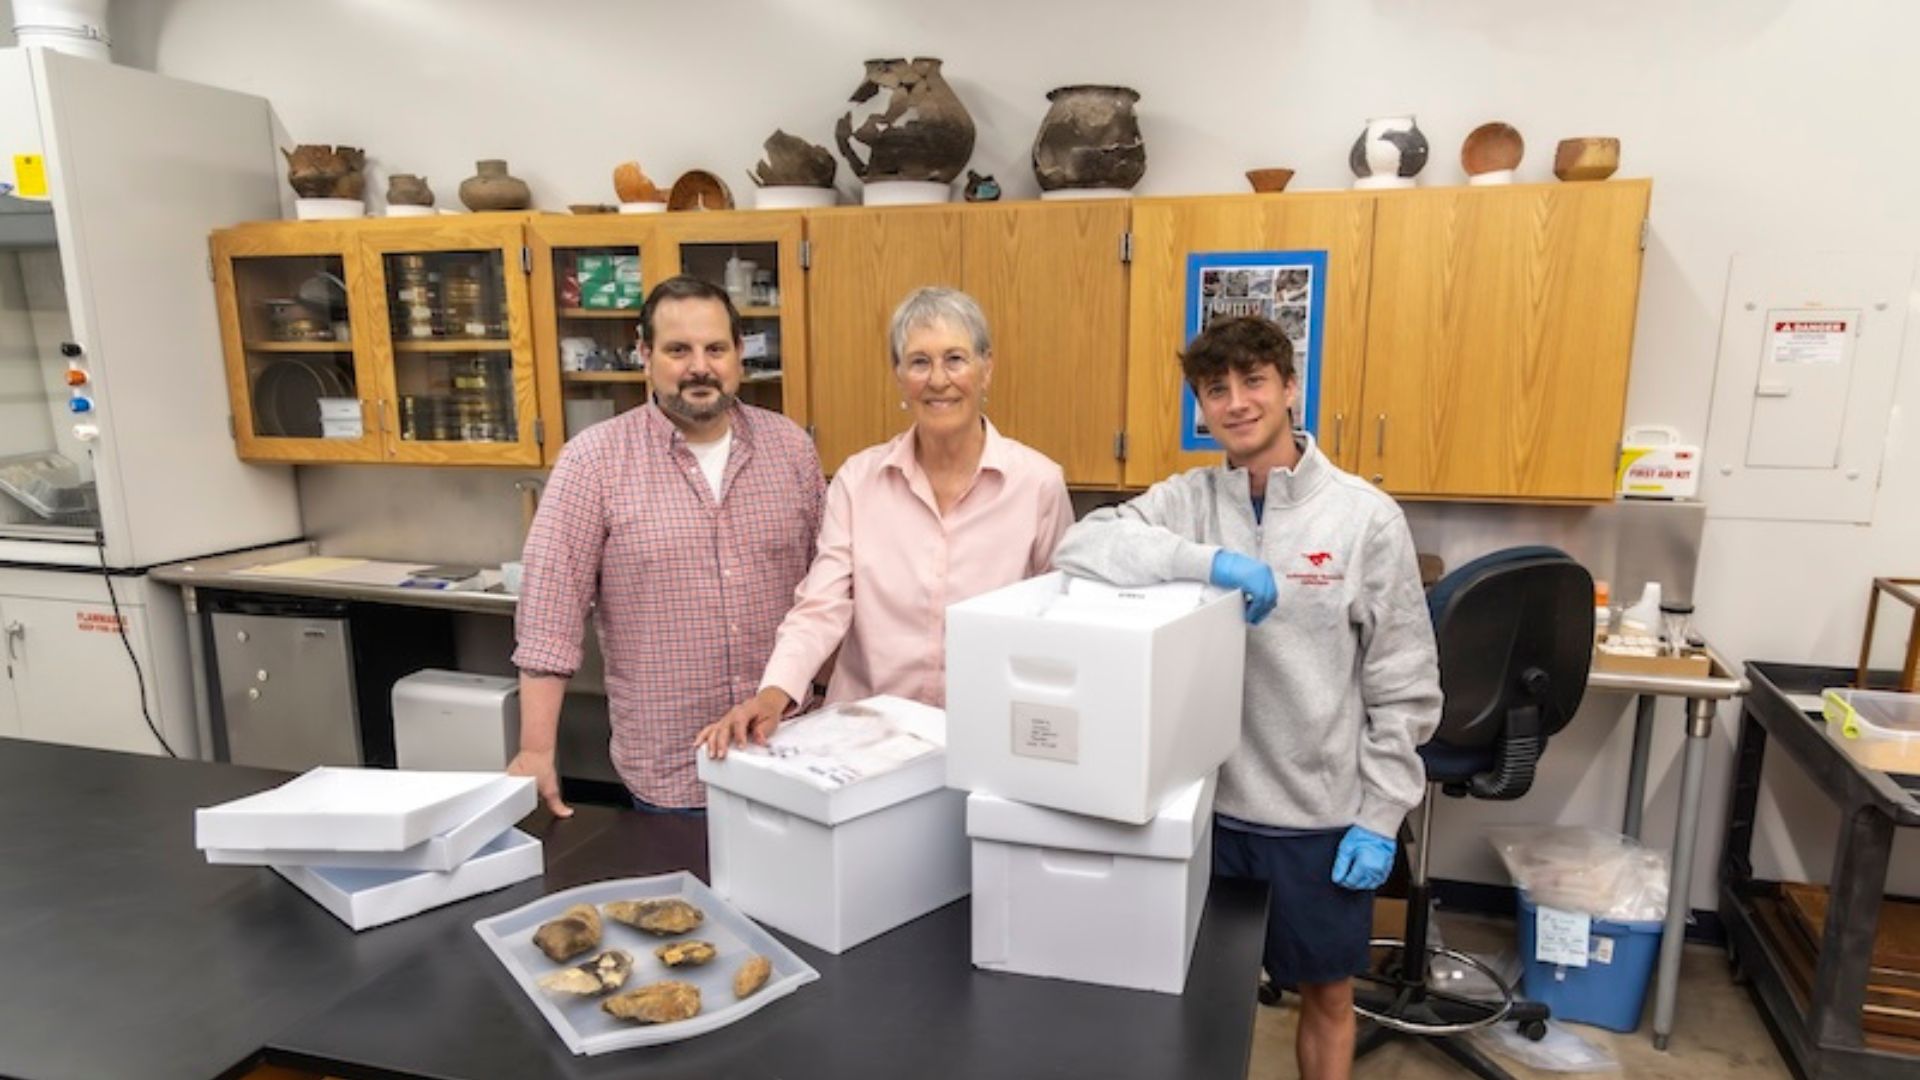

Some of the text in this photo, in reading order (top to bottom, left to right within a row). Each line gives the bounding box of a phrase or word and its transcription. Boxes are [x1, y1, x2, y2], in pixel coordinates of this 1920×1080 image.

[1629, 468, 1691, 479] FIRST AID KIT
